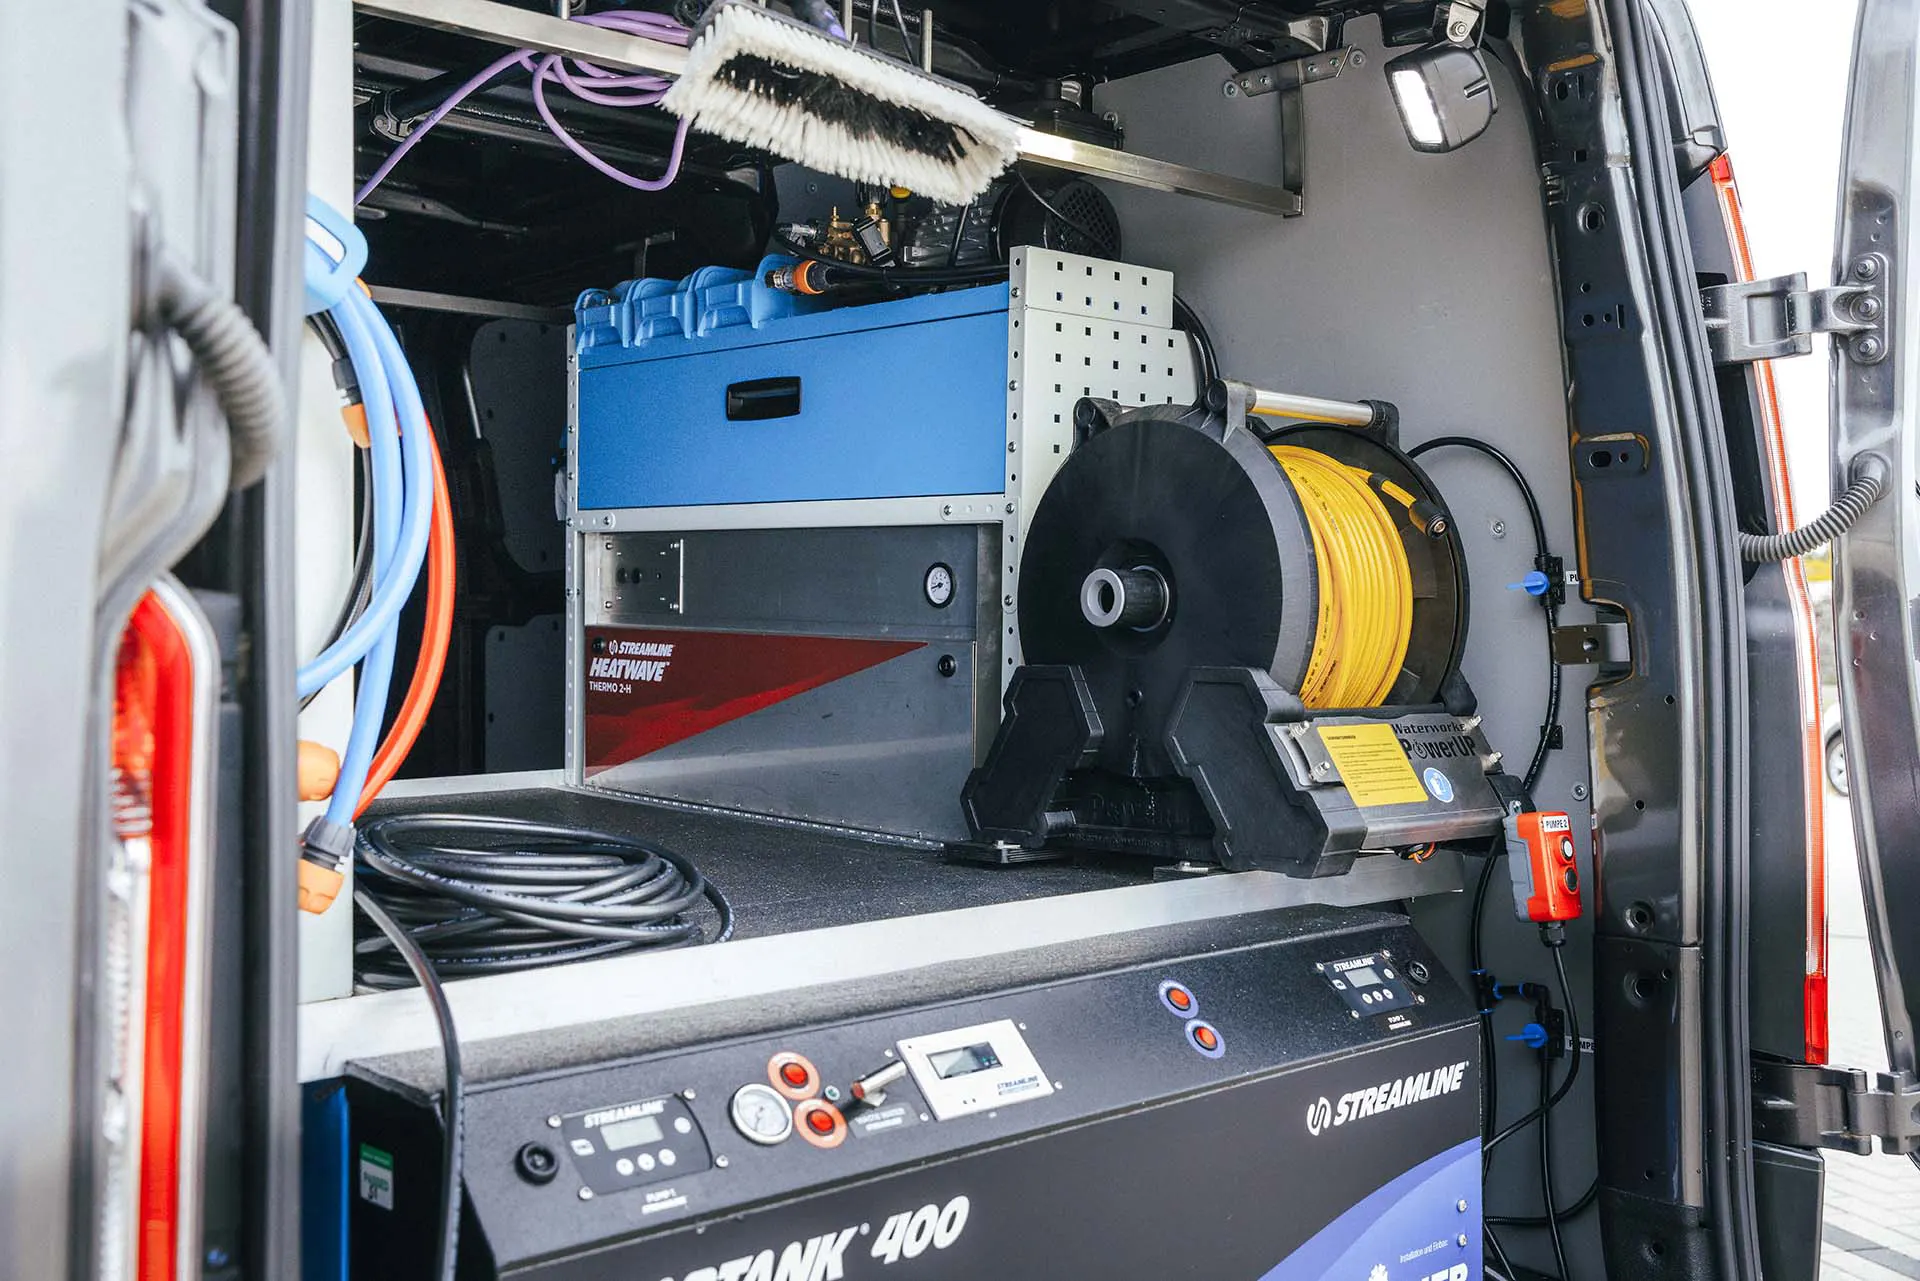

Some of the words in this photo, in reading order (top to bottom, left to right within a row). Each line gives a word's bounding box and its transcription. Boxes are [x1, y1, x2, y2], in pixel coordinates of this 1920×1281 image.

[619, 641, 673, 656] STREAMLINE
[589, 657, 666, 682] HEATWAVE
[589, 681, 617, 693] THERMO
[619, 683, 632, 694] 2-H
[1399, 735, 1475, 760] PowerUP
[1546, 819, 1563, 829] PUMPE
[1563, 819, 1568, 828] 2
[1333, 957, 1375, 973] STREAMLINE
[1569, 1039, 1595, 1052] PMPE
[1333, 1061, 1465, 1127] STREAMLINE
[584, 1100, 666, 1128] STREAMLINE
[871, 1195, 970, 1265] 400
